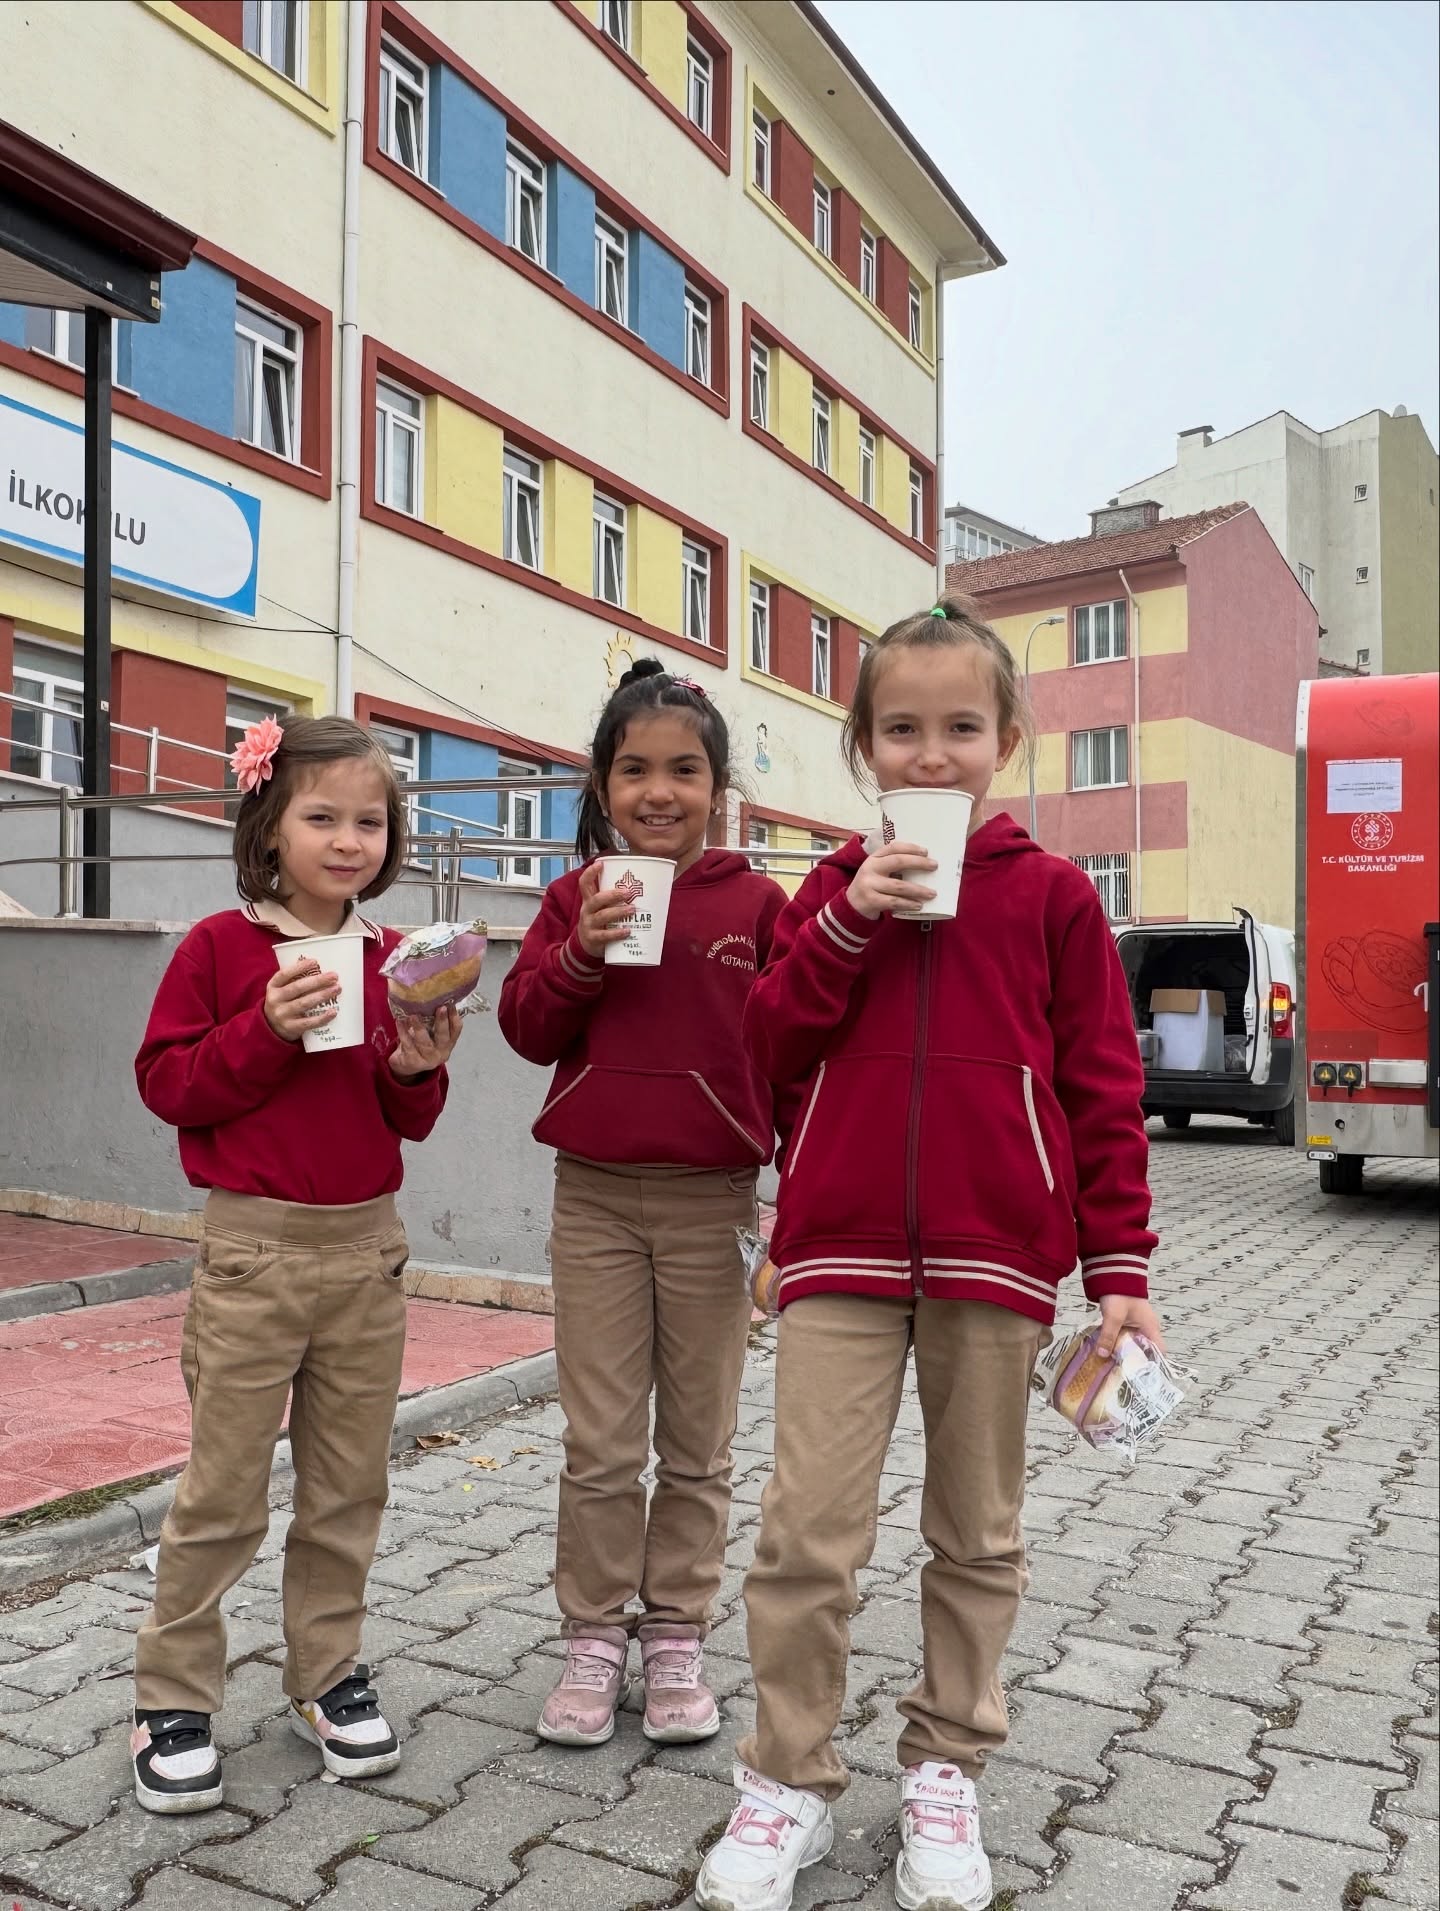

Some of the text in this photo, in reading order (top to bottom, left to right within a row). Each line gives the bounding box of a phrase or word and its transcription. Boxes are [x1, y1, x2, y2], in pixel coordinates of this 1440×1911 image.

[9, 469, 146, 545] İLKOKLU
[1338, 854, 1373, 864] KÜLTÜR
[1375, 855, 1387, 863] VE
[1389, 853, 1424, 863] TURİZM
[1348, 863, 1397, 873] BAKANLIĞI
